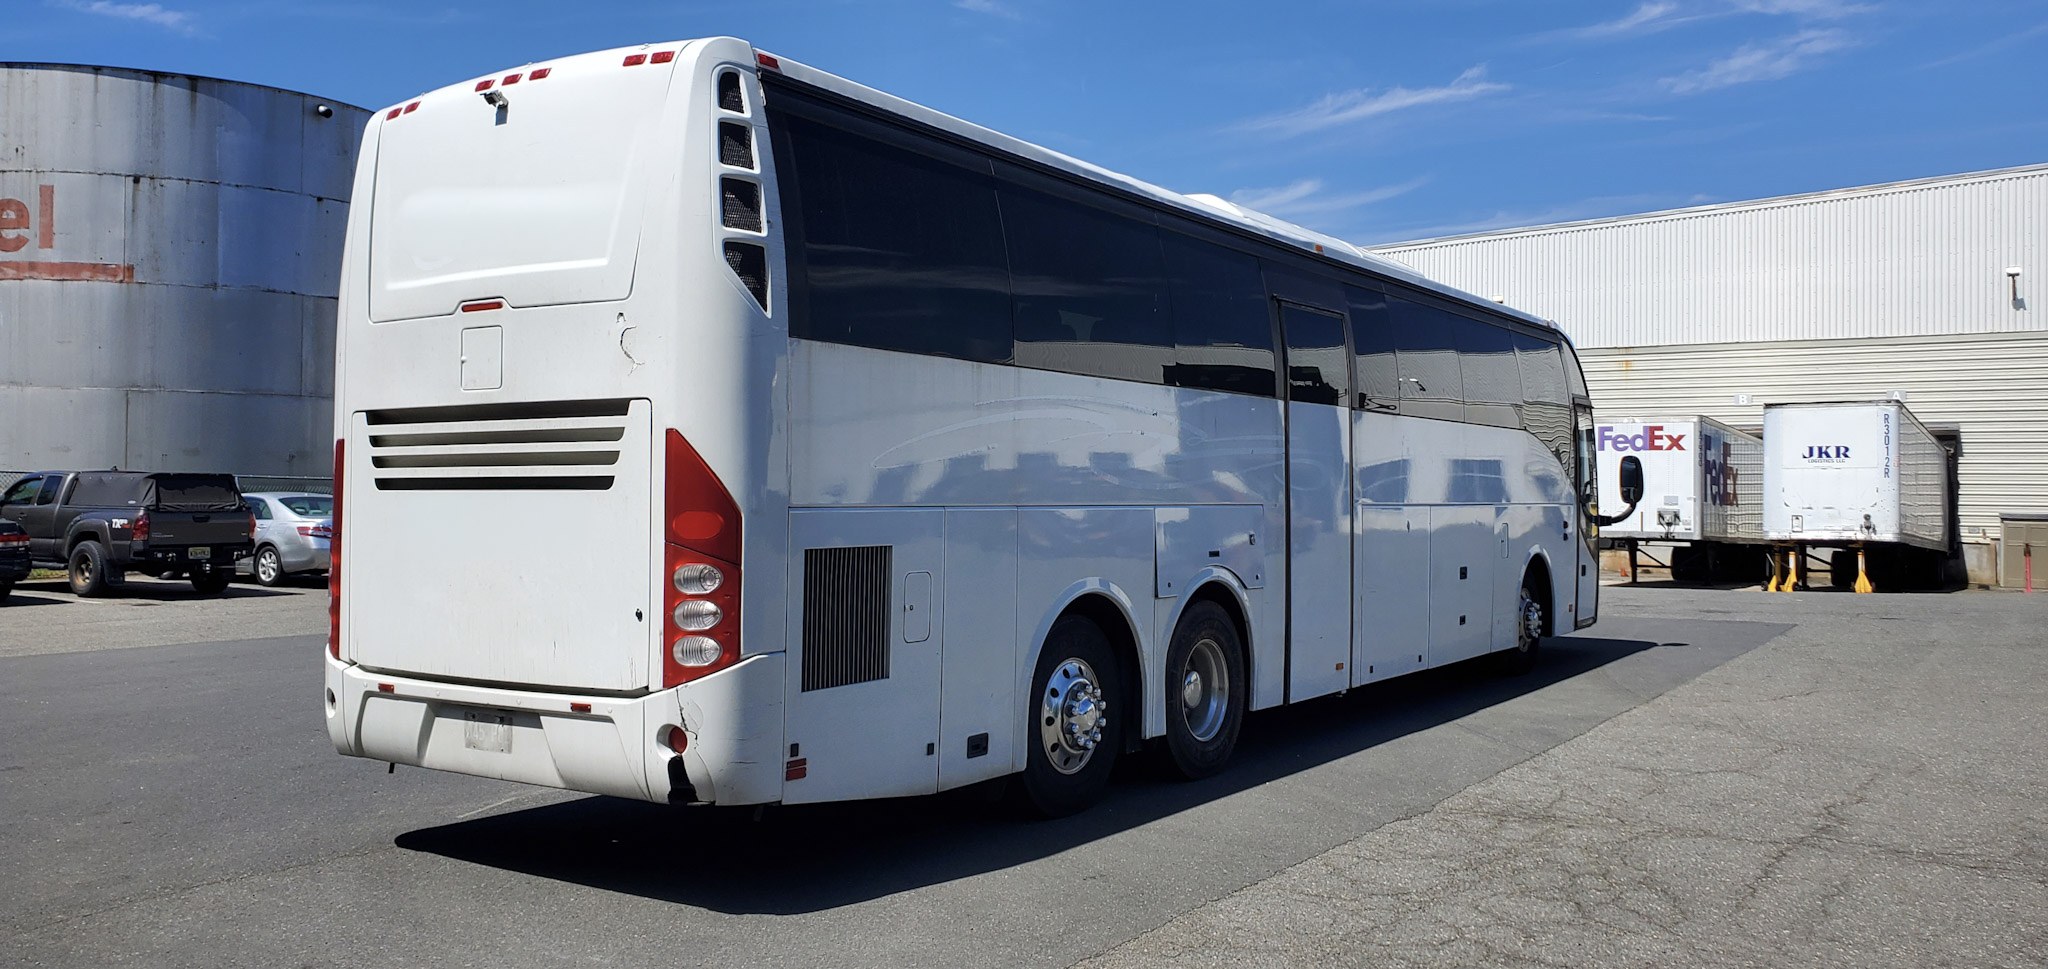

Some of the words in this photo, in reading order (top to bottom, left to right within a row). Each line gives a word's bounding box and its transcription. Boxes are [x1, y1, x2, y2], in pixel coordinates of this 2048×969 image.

[1598, 426, 1686, 451] FedEx
[1802, 446, 1850, 458] JKR
[1704, 434, 1738, 507] FedEx
